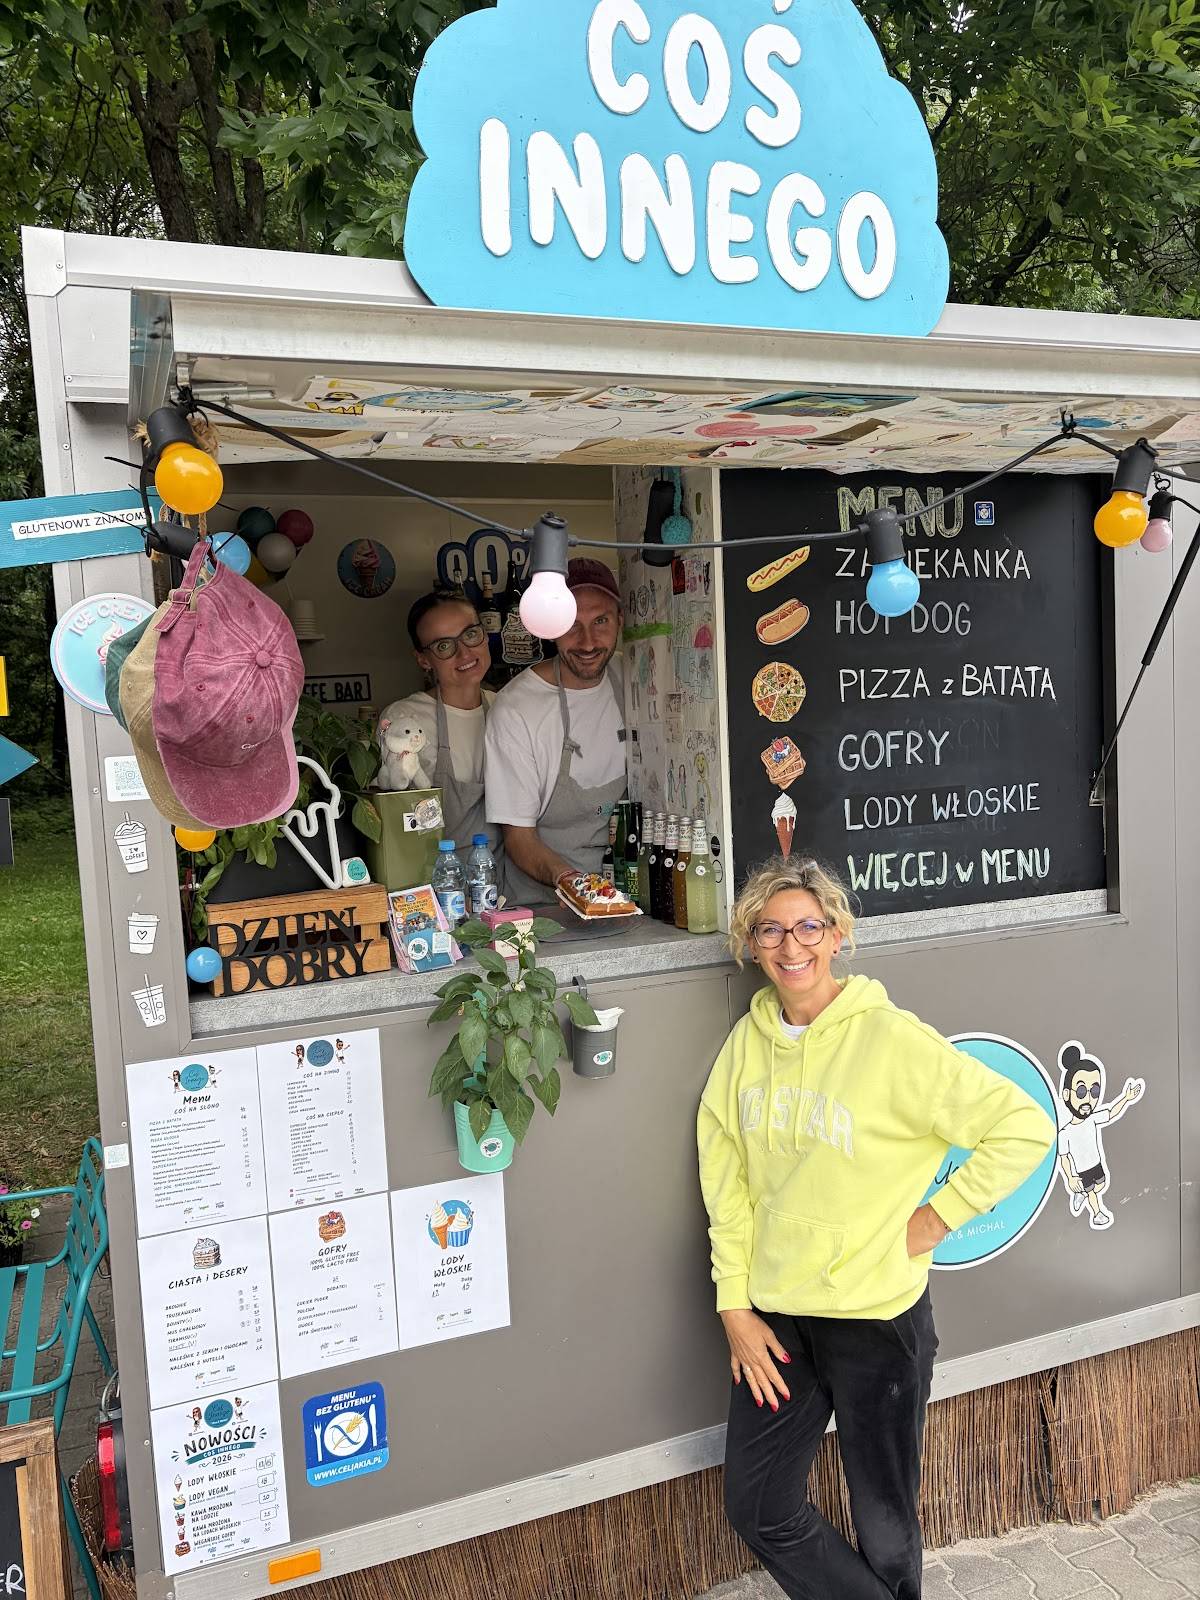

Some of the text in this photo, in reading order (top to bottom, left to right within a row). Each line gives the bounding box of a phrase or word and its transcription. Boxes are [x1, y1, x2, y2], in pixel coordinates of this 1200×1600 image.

[480, 117, 897, 300] INNEGO
[18, 518, 91, 535] GLUTENOWI
[69, 609, 97, 637] ICE
[911, 601, 971, 636] DOG
[334, 681, 362, 701] BAR
[839, 668, 931, 703] PIZZA
[961, 663, 1057, 702] BATATA
[838, 729, 950, 771] GOFRY
[843, 793, 918, 832] LODY
[931, 782, 1041, 821] WŁOSKIE
[847, 851, 948, 892] WIĘCEJ
[981, 847, 1051, 885] MENU
[220, 939, 374, 997] DOBRY
[182, 1094, 211, 1105] Menu
[957, 1230, 964, 1240] &
[318, 1243, 348, 1257] GOFRY
[325, 1254, 345, 1262] GLUTEN
[346, 1250, 360, 1258] FREE
[327, 1260, 344, 1268] LACTO
[441, 1254, 465, 1266] LODY
[168, 1275, 202, 1290] CIASTA
[213, 1266, 249, 1280] DESERY
[434, 1263, 472, 1278] WŁOSKIE
[331, 1390, 356, 1404] MENU
[316, 1396, 372, 1417] BEZ GLUTENU
[183, 1425, 256, 1457] NOWOŚCI
[212, 1454, 232, 1465] 2026
[187, 1476, 204, 1487] LODY
[208, 1468, 237, 1481] WŁOSKIE
[189, 1491, 205, 1502] LODY
[208, 1485, 229, 1497] VEGAN
[190, 1508, 207, 1517] KAWA
[191, 1516, 200, 1524] NA
[192, 1524, 206, 1532] KAWA
